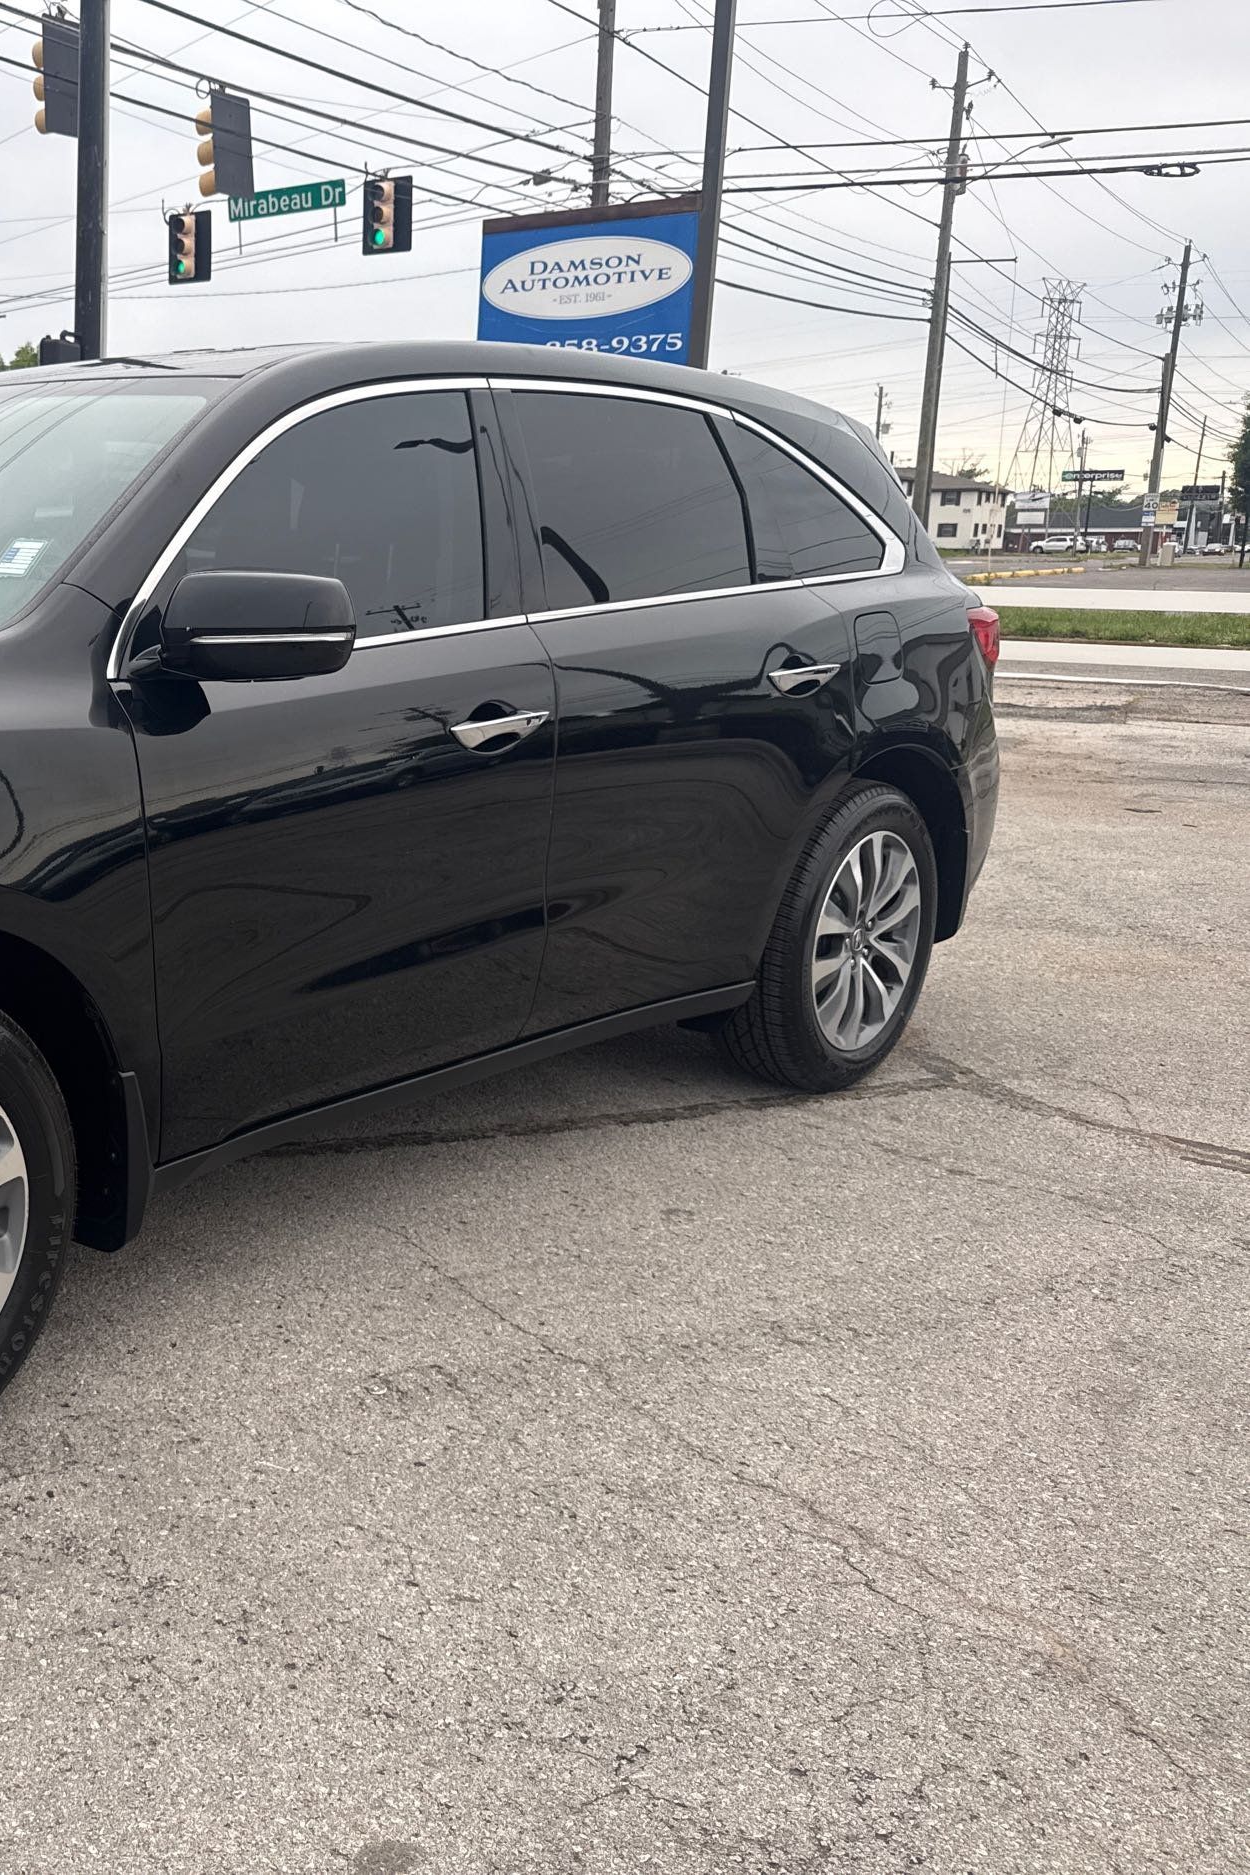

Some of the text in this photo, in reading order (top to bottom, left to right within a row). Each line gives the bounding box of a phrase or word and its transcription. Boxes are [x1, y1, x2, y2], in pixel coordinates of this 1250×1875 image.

[230, 184, 343, 219] Mirabeau Dr
[529, 253, 642, 276] DAMSON
[500, 267, 672, 294] AUTOMOTIVE
[558, 291, 606, 305] EST. 1961
[1144, 502, 1159, 510] 40
